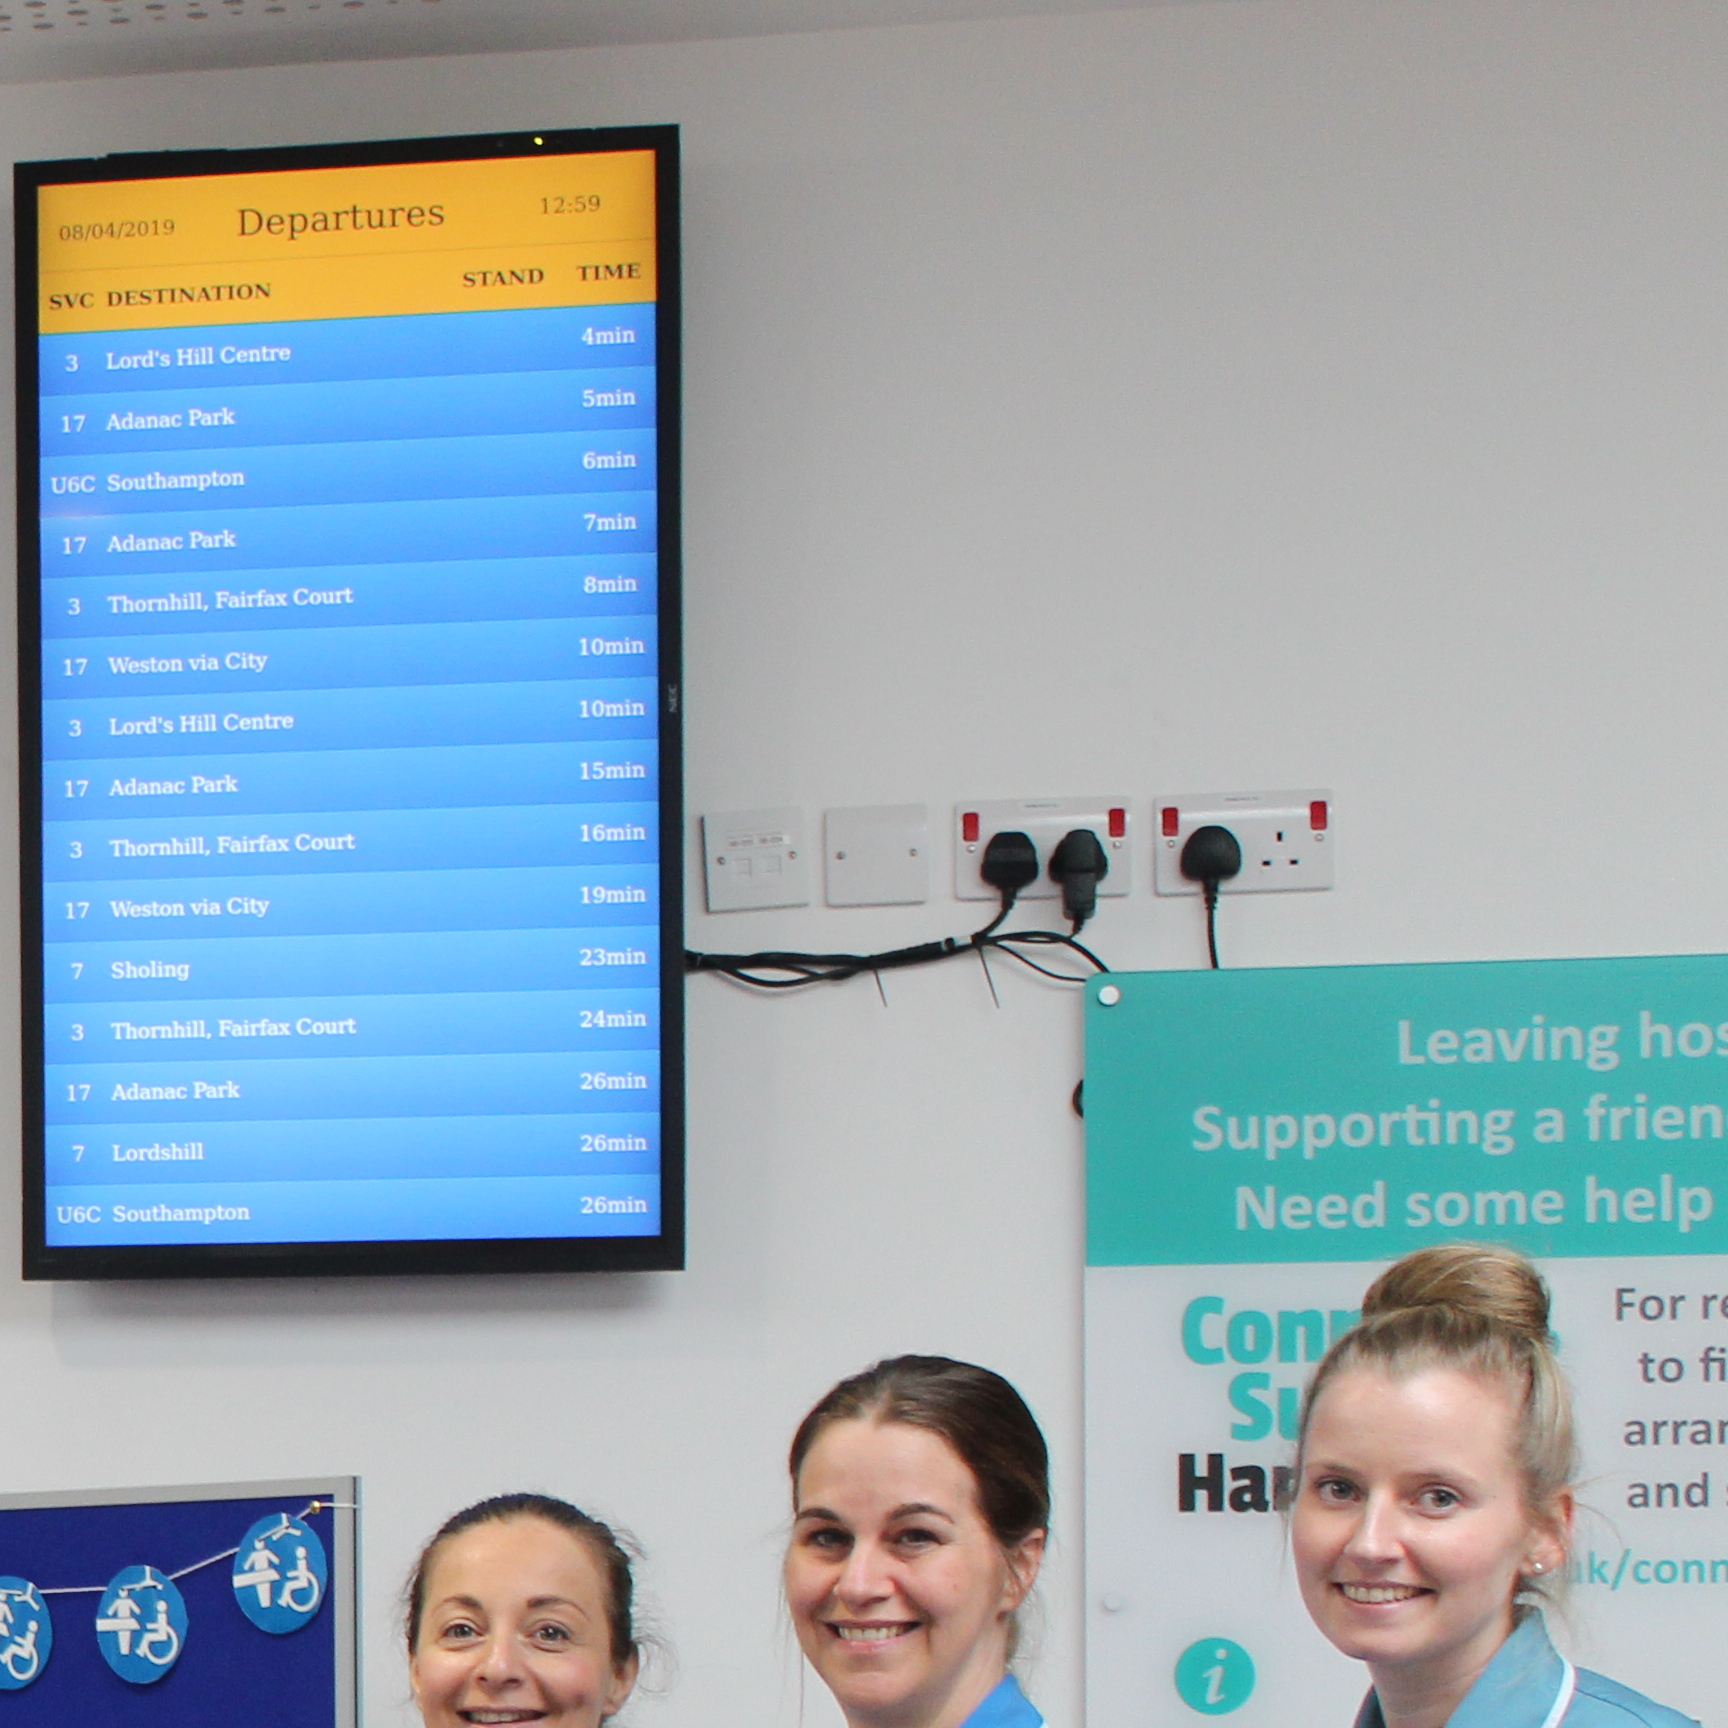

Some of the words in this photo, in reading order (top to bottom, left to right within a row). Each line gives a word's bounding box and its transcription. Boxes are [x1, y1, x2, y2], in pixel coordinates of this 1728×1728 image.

[58, 219, 176, 242] 08/04/2019
[236, 201, 445, 241] Departures
[539, 195, 601, 216] 12:59
[48, 293, 95, 310] SVC
[105, 283, 272, 309] DESTINATION
[462, 268, 545, 288] STAND
[576, 263, 641, 282] TIME
[65, 354, 79, 372] 3
[105, 349, 170, 371] Lord's
[176, 346, 214, 368] Hill
[220, 343, 292, 365] Centre
[581, 326, 636, 346] 4min
[60, 415, 87, 433] 17
[105, 411, 183, 432] Adanac
[189, 408, 236, 428] Park
[582, 388, 637, 408] 5min
[50, 476, 96, 494] U6C
[106, 470, 245, 496] Southampton
[582, 450, 637, 470] 6min
[61, 537, 88, 555] 17
[107, 532, 184, 553] Adanac
[190, 530, 237, 549] Park
[583, 512, 638, 532] 7min
[67, 598, 81, 616] 3
[108, 592, 210, 618] Thornhill,
[215, 590, 287, 611] Fairfax
[293, 587, 354, 607] Court
[583, 575, 638, 595] 8min
[63, 658, 88, 677] 17
[108, 655, 183, 675] Weston
[189, 654, 219, 672] via
[225, 651, 268, 673] City
[578, 636, 645, 657] 10min
[68, 720, 82, 737] 3
[109, 715, 172, 736] Lord's
[179, 713, 217, 733] Hill
[222, 711, 294, 731] Centre
[579, 698, 646, 719] 10min
[64, 781, 89, 798] 17
[109, 777, 186, 798] Adanac
[192, 774, 238, 794] Park
[579, 760, 646, 781] 15min
[70, 841, 83, 859] 3
[110, 837, 211, 863] Thornhill,
[217, 835, 289, 856] Fairfax
[295, 832, 355, 853] Court
[580, 823, 646, 844] 16min
[64, 902, 90, 920] 17
[111, 900, 184, 920] Weston
[191, 898, 221, 917] via
[227, 896, 270, 918] City
[580, 885, 647, 906] 19min
[72, 963, 83, 980] 7
[111, 960, 190, 982] Sholing
[580, 947, 647, 968] 23min
[71, 1023, 84, 1041] 3
[111, 1021, 213, 1046] Thornhill,
[218, 1019, 290, 1039] Fairfax
[296, 1016, 357, 1037] Court
[580, 1009, 647, 1030] 24min
[1397, 1015, 1621, 1071] Leaving
[66, 1084, 91, 1102] 17
[111, 1081, 187, 1102] Adanac
[194, 1079, 241, 1098] Park
[580, 1071, 647, 1092] 26min
[1192, 1099, 1515, 1161] Supporting
[1533, 1106, 1566, 1144] a
[1584, 1093, 1724, 1142] frien
[73, 1145, 84, 1162] 7
[112, 1141, 204, 1163] Lordshill
[580, 1133, 647, 1155] 26min
[56, 1205, 101, 1224] U6C
[113, 1203, 250, 1228] Southampton
[581, 1196, 648, 1217] 26min
[1234, 1181, 1387, 1231] Need
[1405, 1188, 1565, 1227] some
[1584, 1173, 1714, 1233] help
[1615, 1288, 1686, 1321] For
[1638, 1352, 1685, 1383] to
[1626, 1472, 1710, 1508] and
